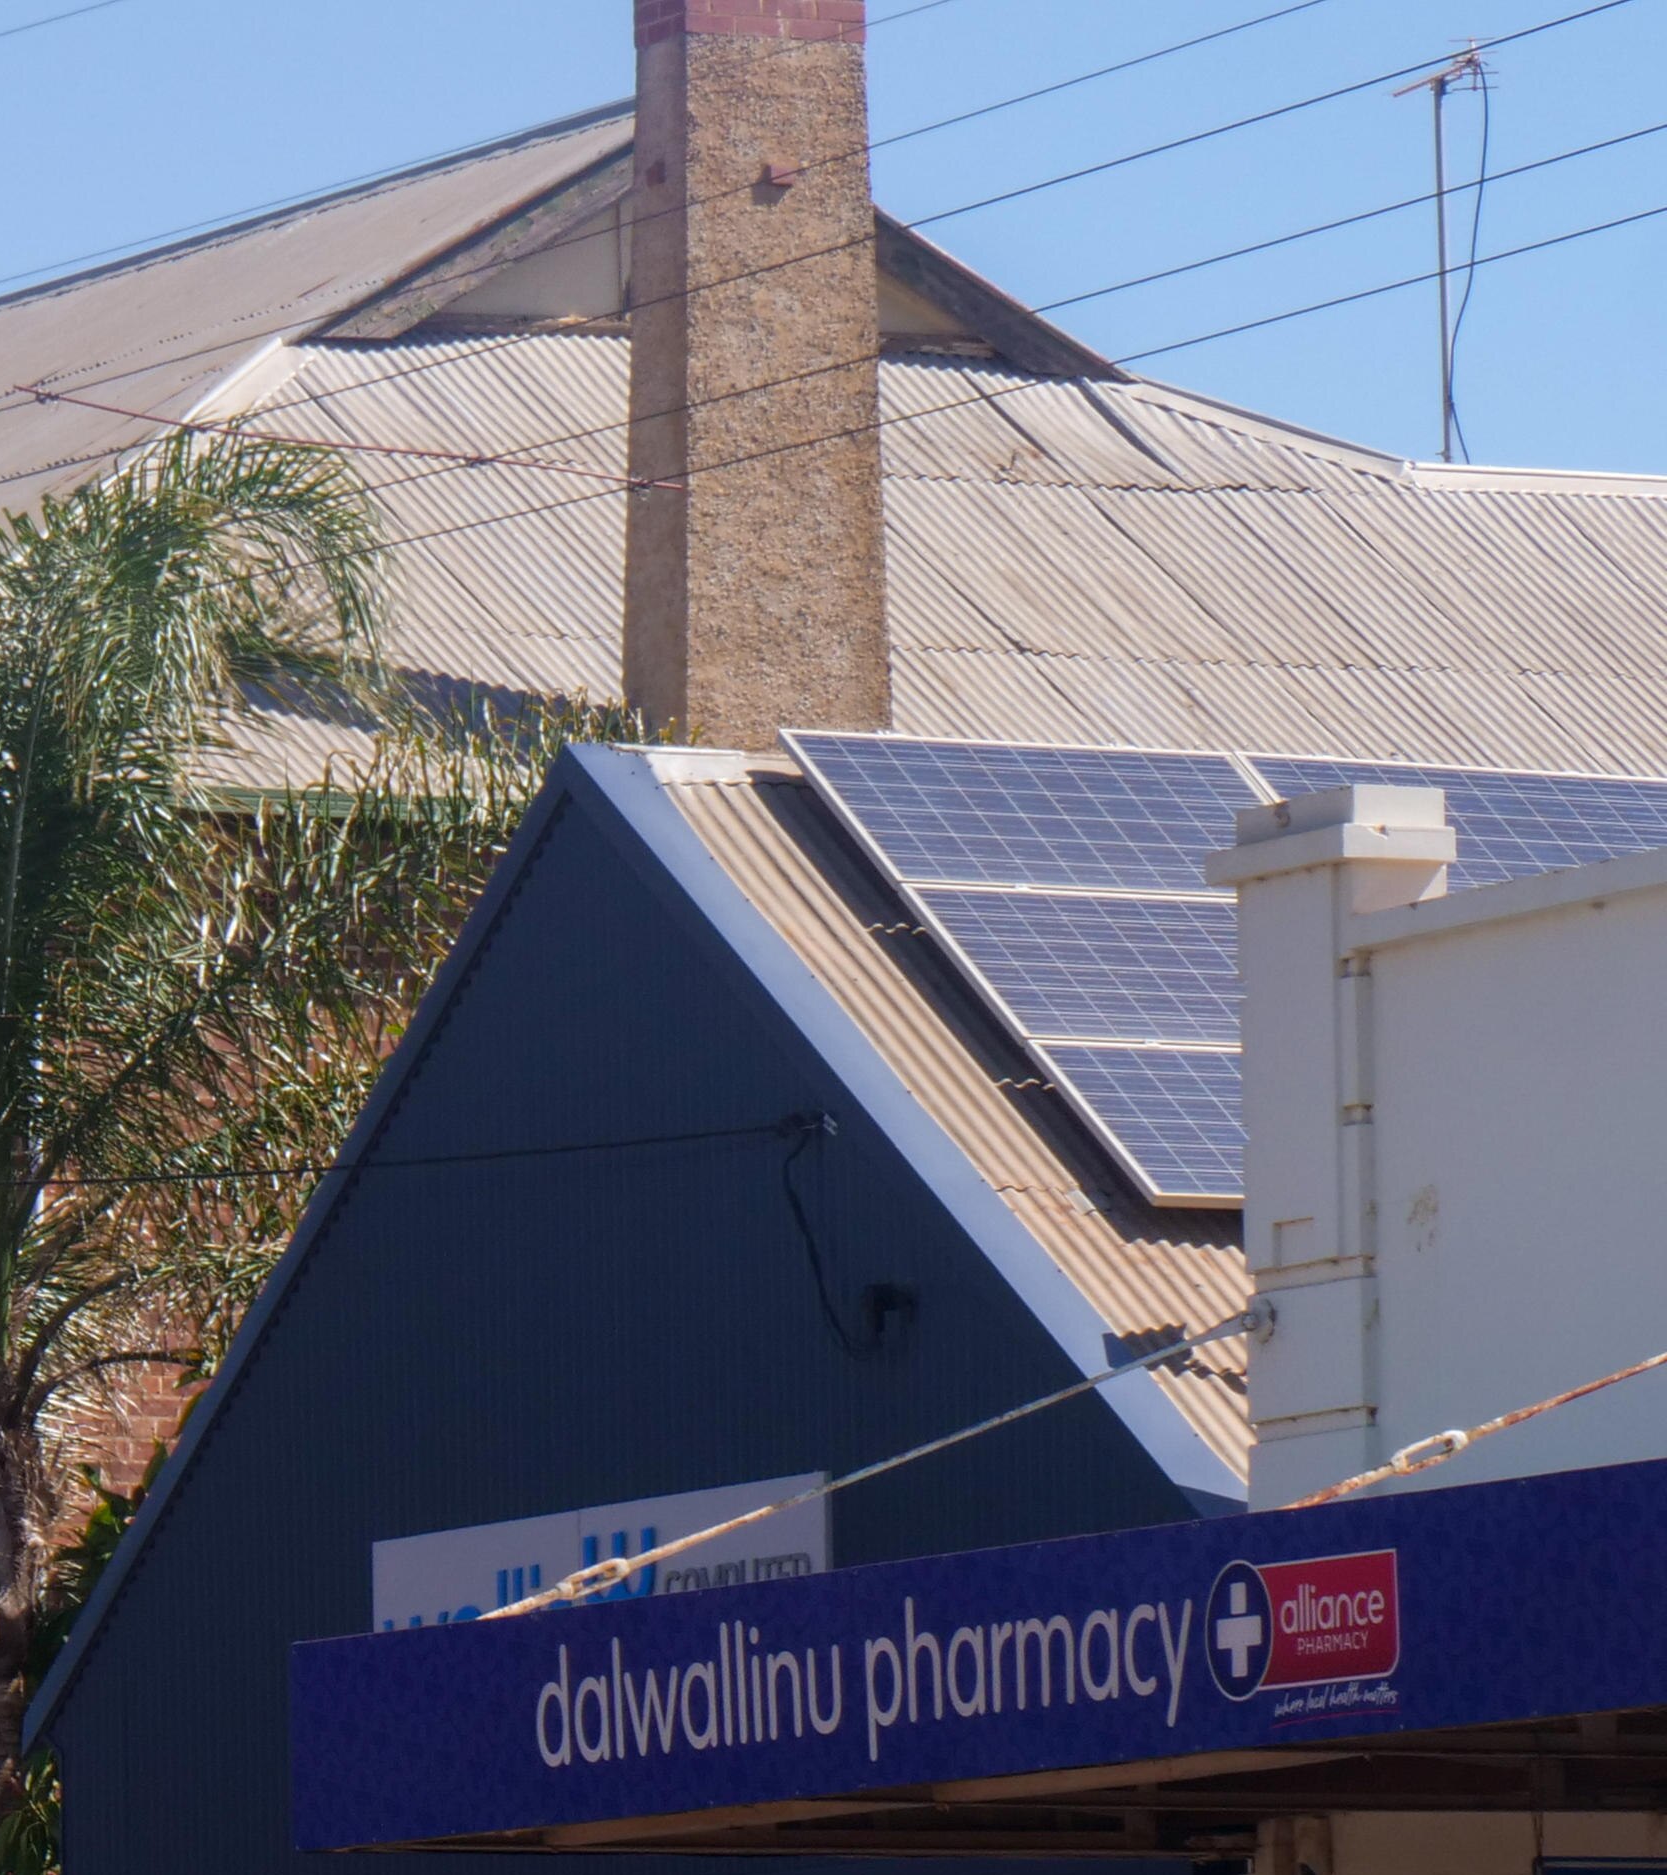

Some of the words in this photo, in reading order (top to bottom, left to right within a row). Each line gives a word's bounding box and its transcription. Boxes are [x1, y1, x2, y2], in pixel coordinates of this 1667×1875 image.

[1280, 1583, 1386, 1635] alliance
[1296, 1631, 1370, 1656] PHARMACY
[535, 1620, 843, 1768] dalwallinu
[865, 1596, 1192, 1763] pharmacy
